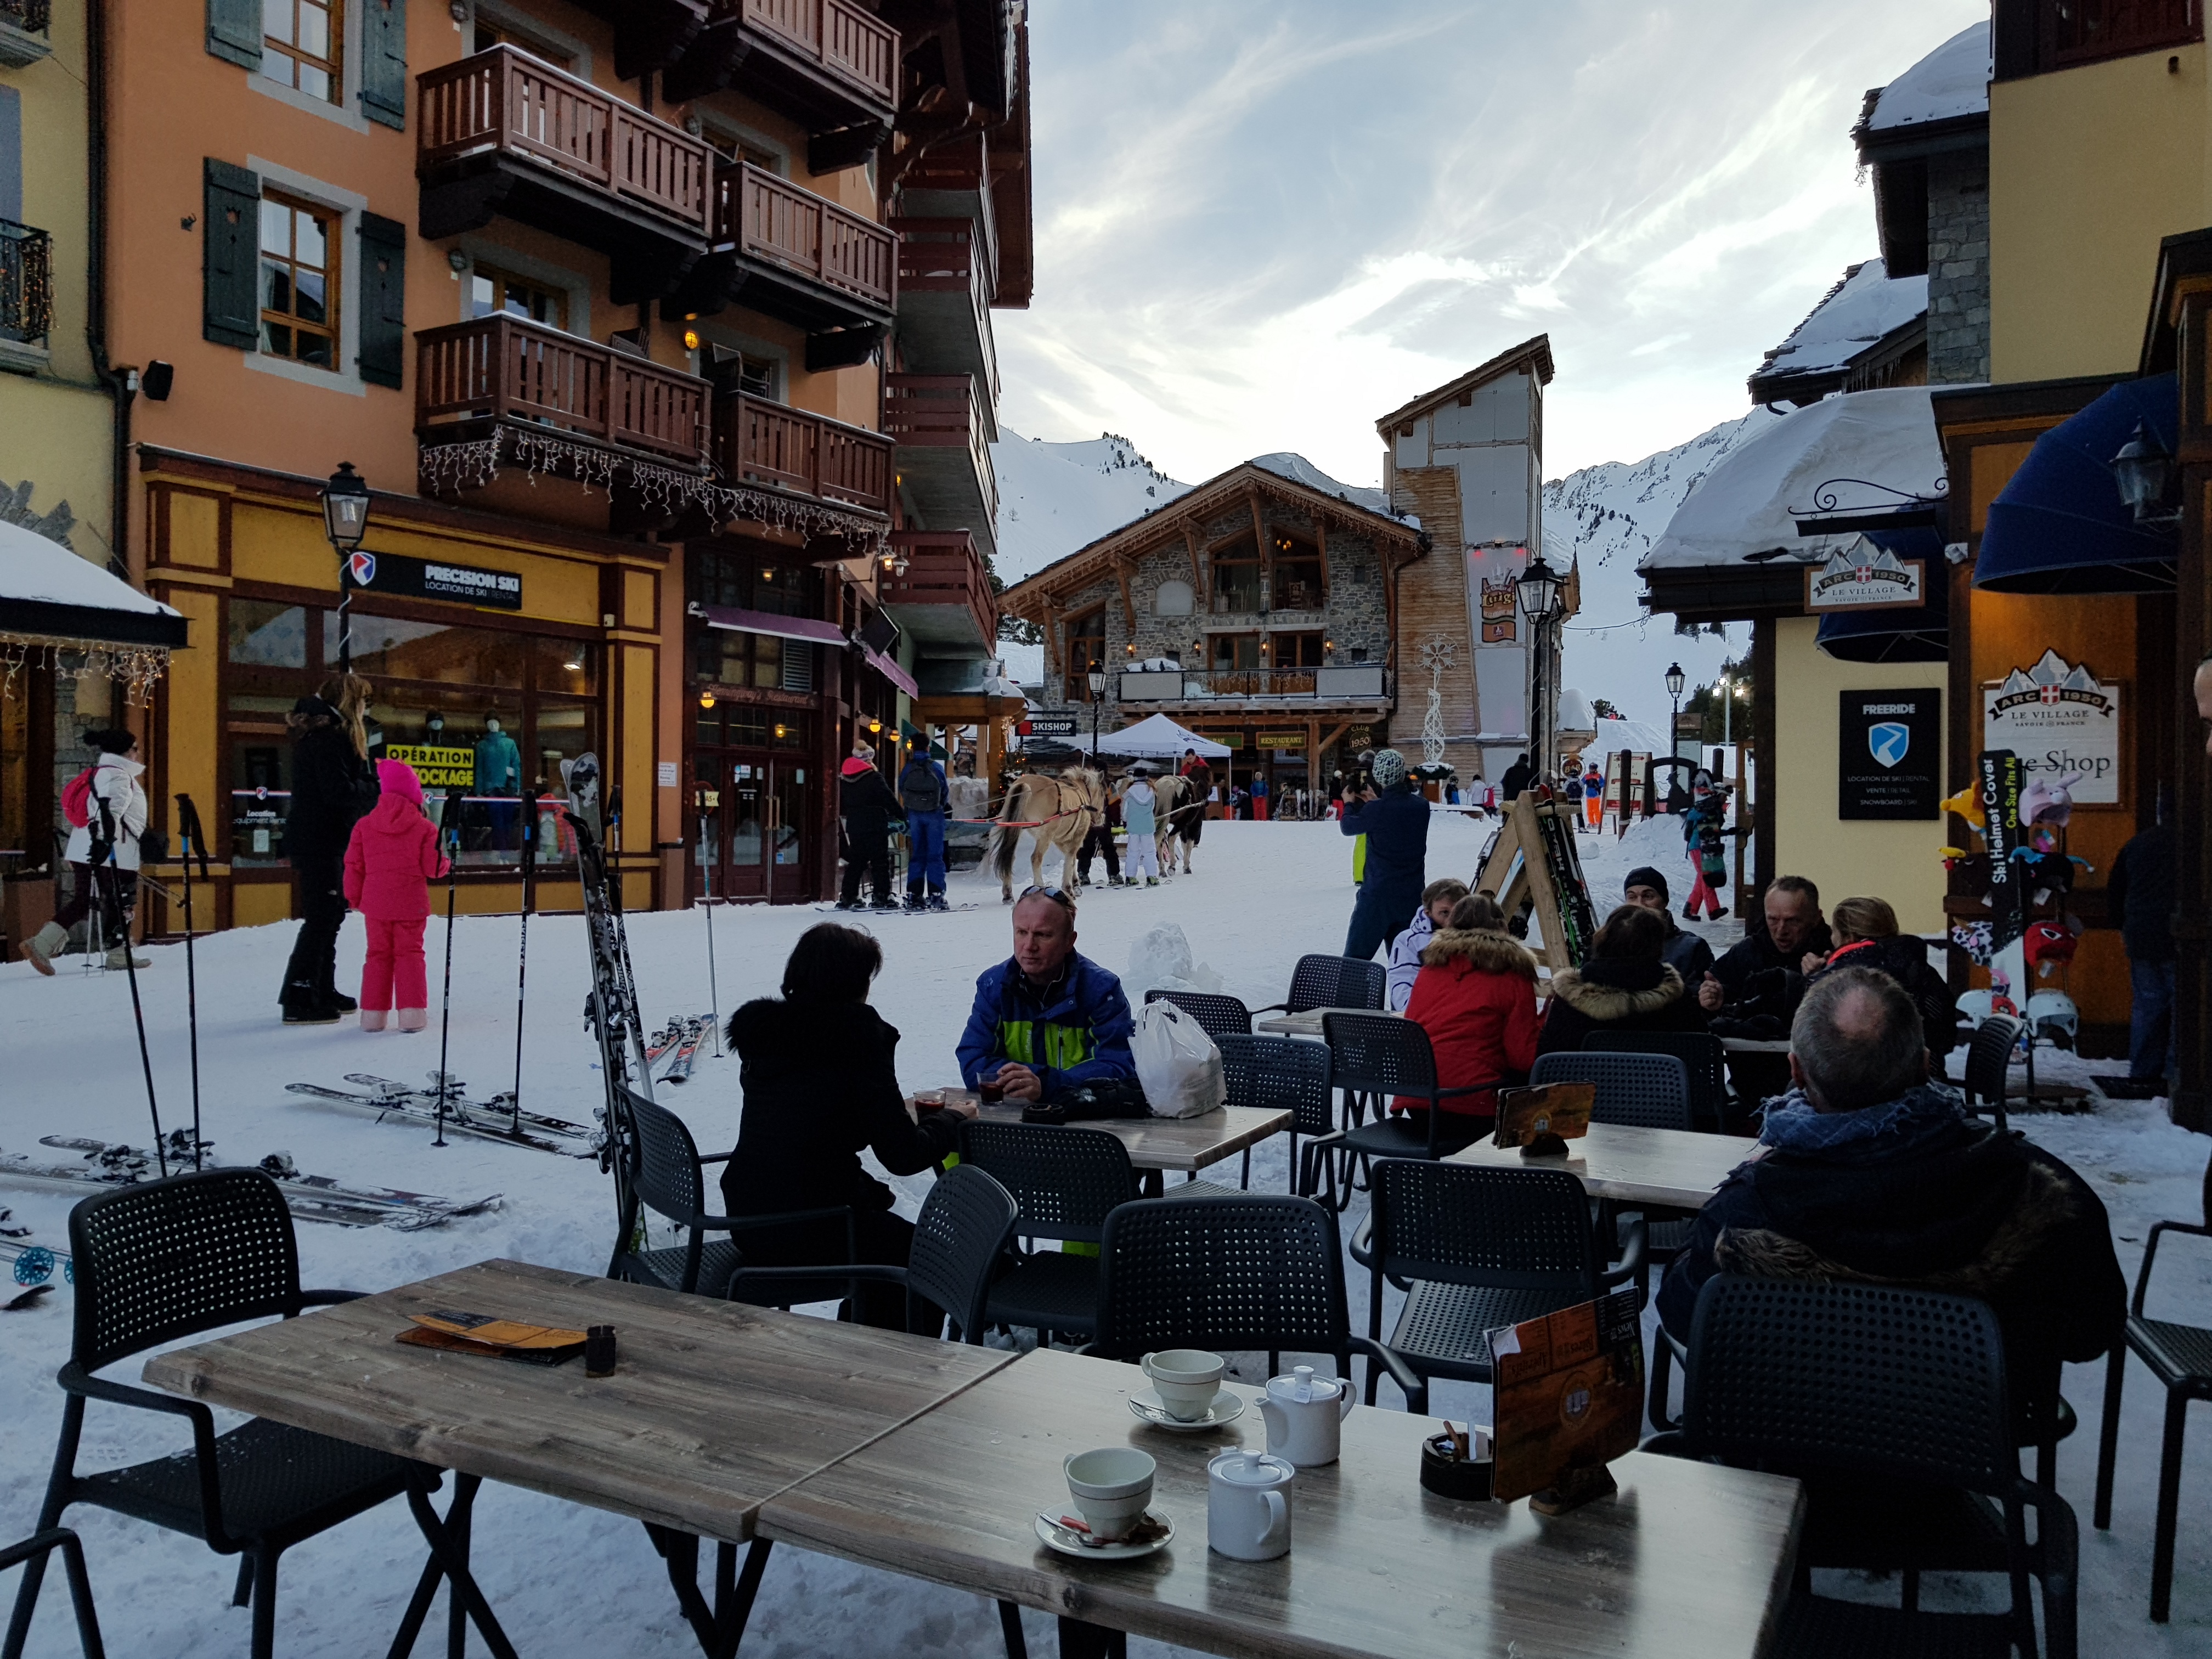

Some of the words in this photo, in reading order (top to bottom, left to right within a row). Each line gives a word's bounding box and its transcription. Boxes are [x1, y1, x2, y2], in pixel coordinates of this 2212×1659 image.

[425, 565, 496, 589] PRECISION
[498, 576, 519, 592] SKI
[1824, 573, 1852, 586] ARC
[1875, 571, 1906, 582] 1950
[425, 581, 464, 594] LOCATION
[465, 586, 475, 595] DE
[476, 588, 487, 597] SKI
[1481, 591, 1515, 607] Luigi
[2001, 693, 2036, 708] ARC
[2064, 691, 2103, 705] 1950
[1863, 703, 1915, 715] FREERIDE
[2032, 710, 2089, 719] VILLAGE
[1032, 723, 1072, 731] SKISHOP
[1351, 738, 1370, 748] 1950
[390, 747, 472, 764] OPÉRATION
[2005, 757, 2016, 769] All
[2046, 749, 2111, 778] Shop
[415, 768, 474, 786] OCKAGE
[1983, 759, 1997, 805] Cover
[2005, 770, 2016, 786] Fits
[2005, 787, 2017, 806] Size
[2006, 808, 2017, 828] One
[1989, 808, 2004, 859] Helmet
[1992, 861, 2007, 884] Ski
[616, 962, 627, 992] OMIC
